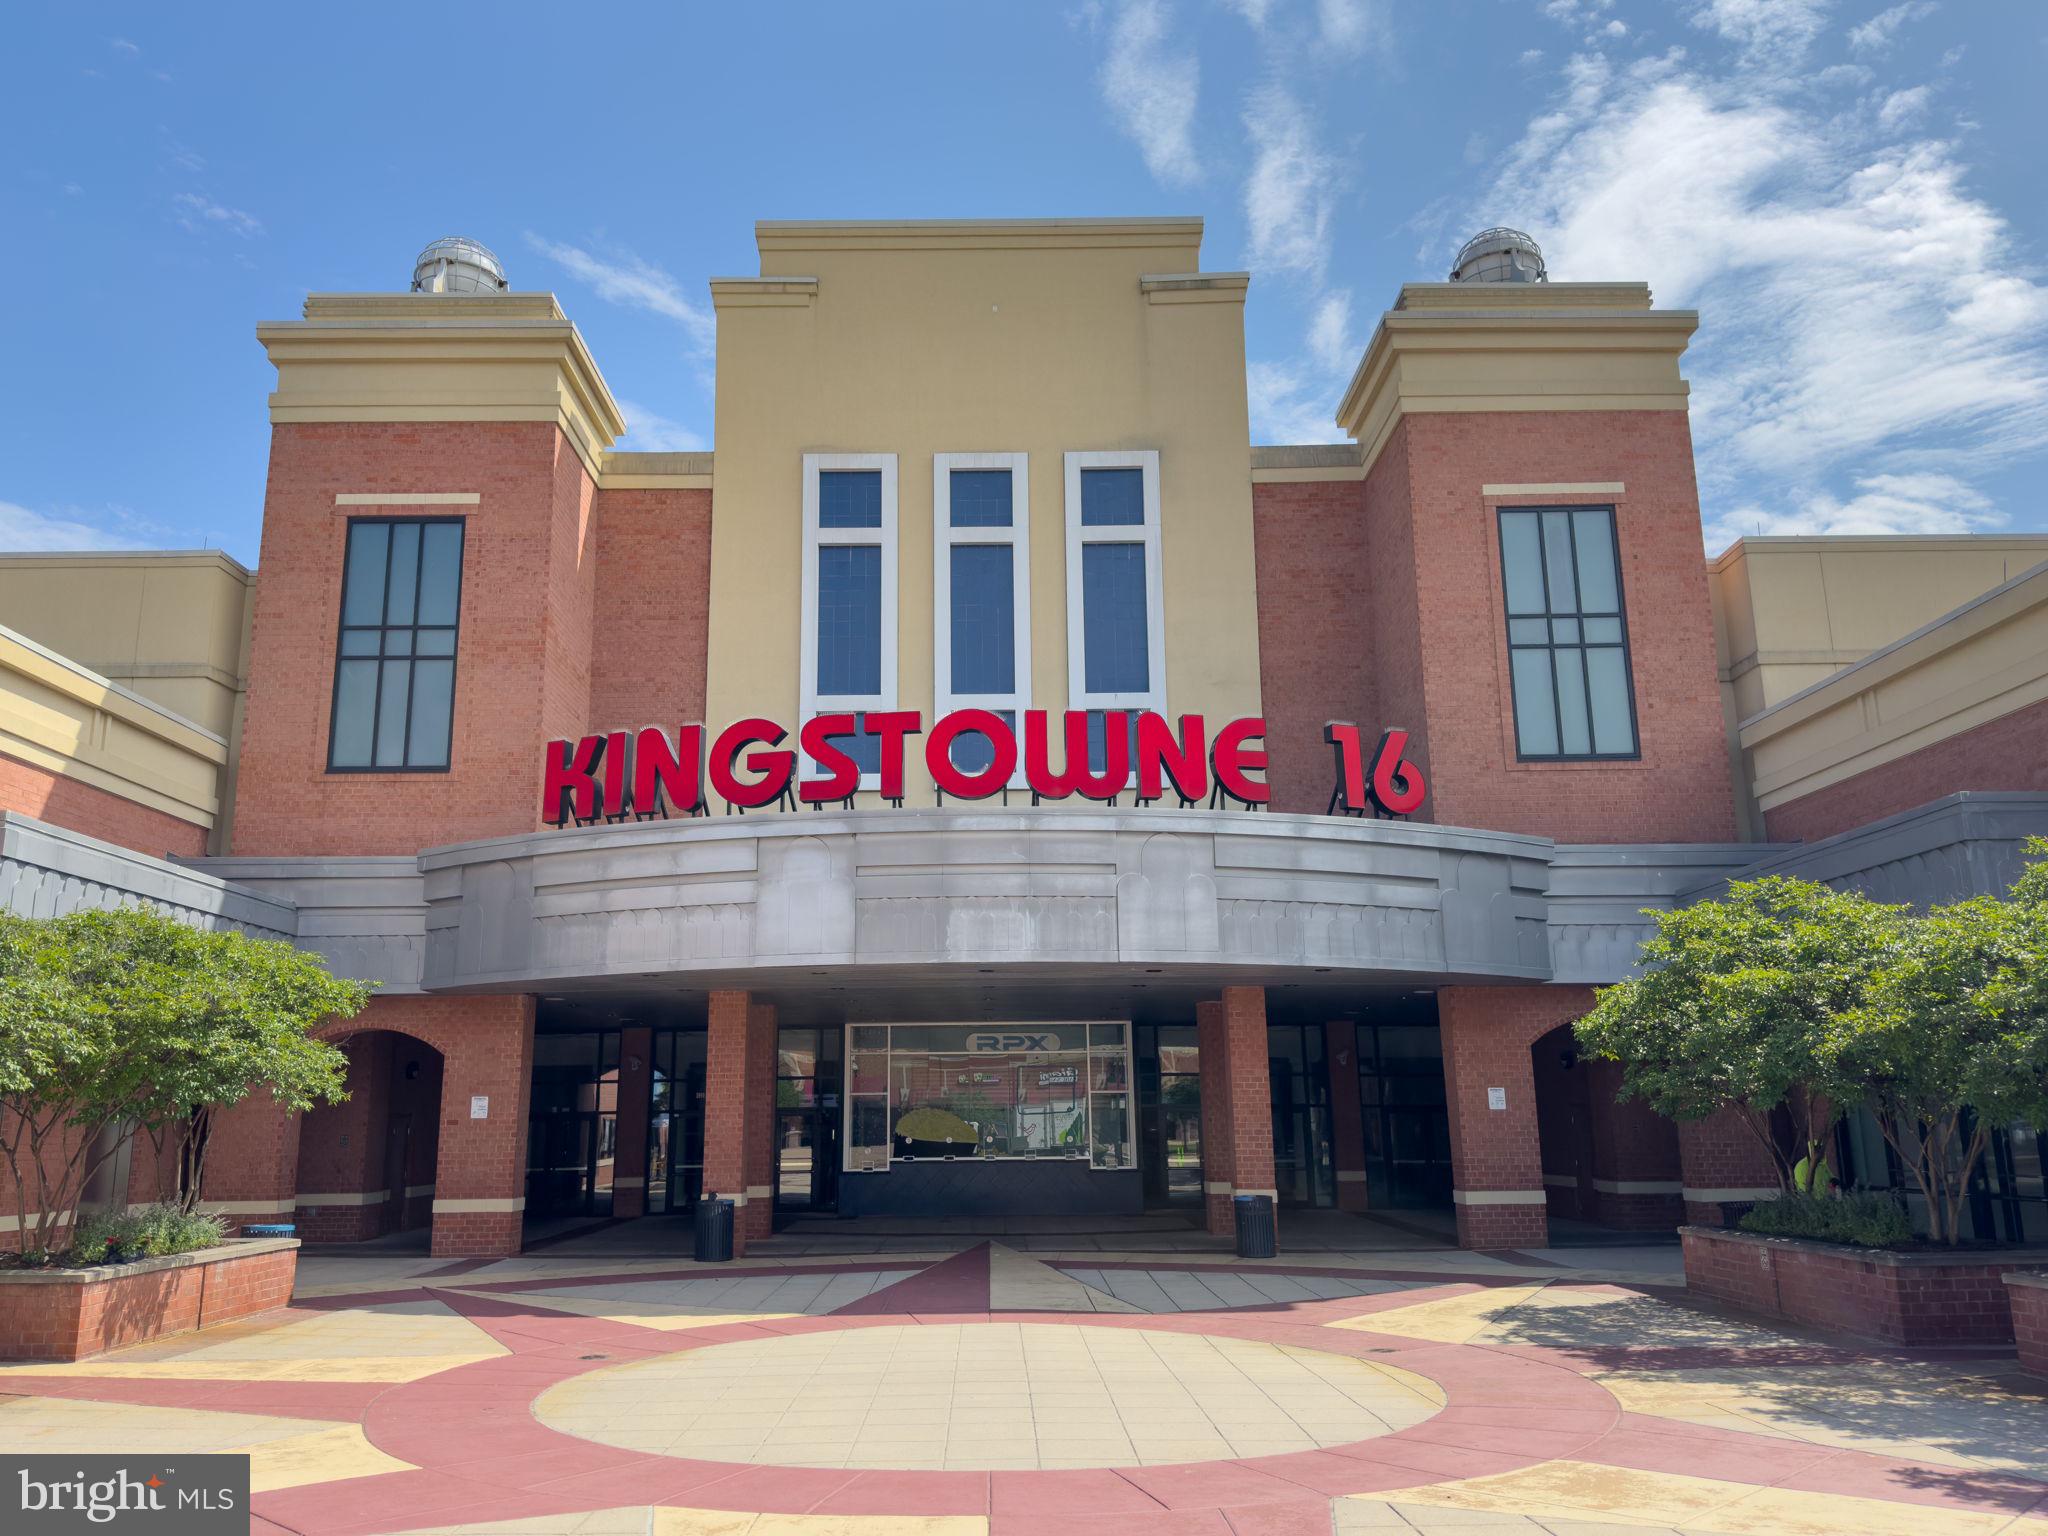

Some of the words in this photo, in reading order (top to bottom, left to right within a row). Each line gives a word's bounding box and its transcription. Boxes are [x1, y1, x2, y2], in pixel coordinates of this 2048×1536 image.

[542, 708, 1271, 825] KINGSTOWNE
[1324, 720, 1426, 816] 16
[976, 1035, 1049, 1051] RPX
